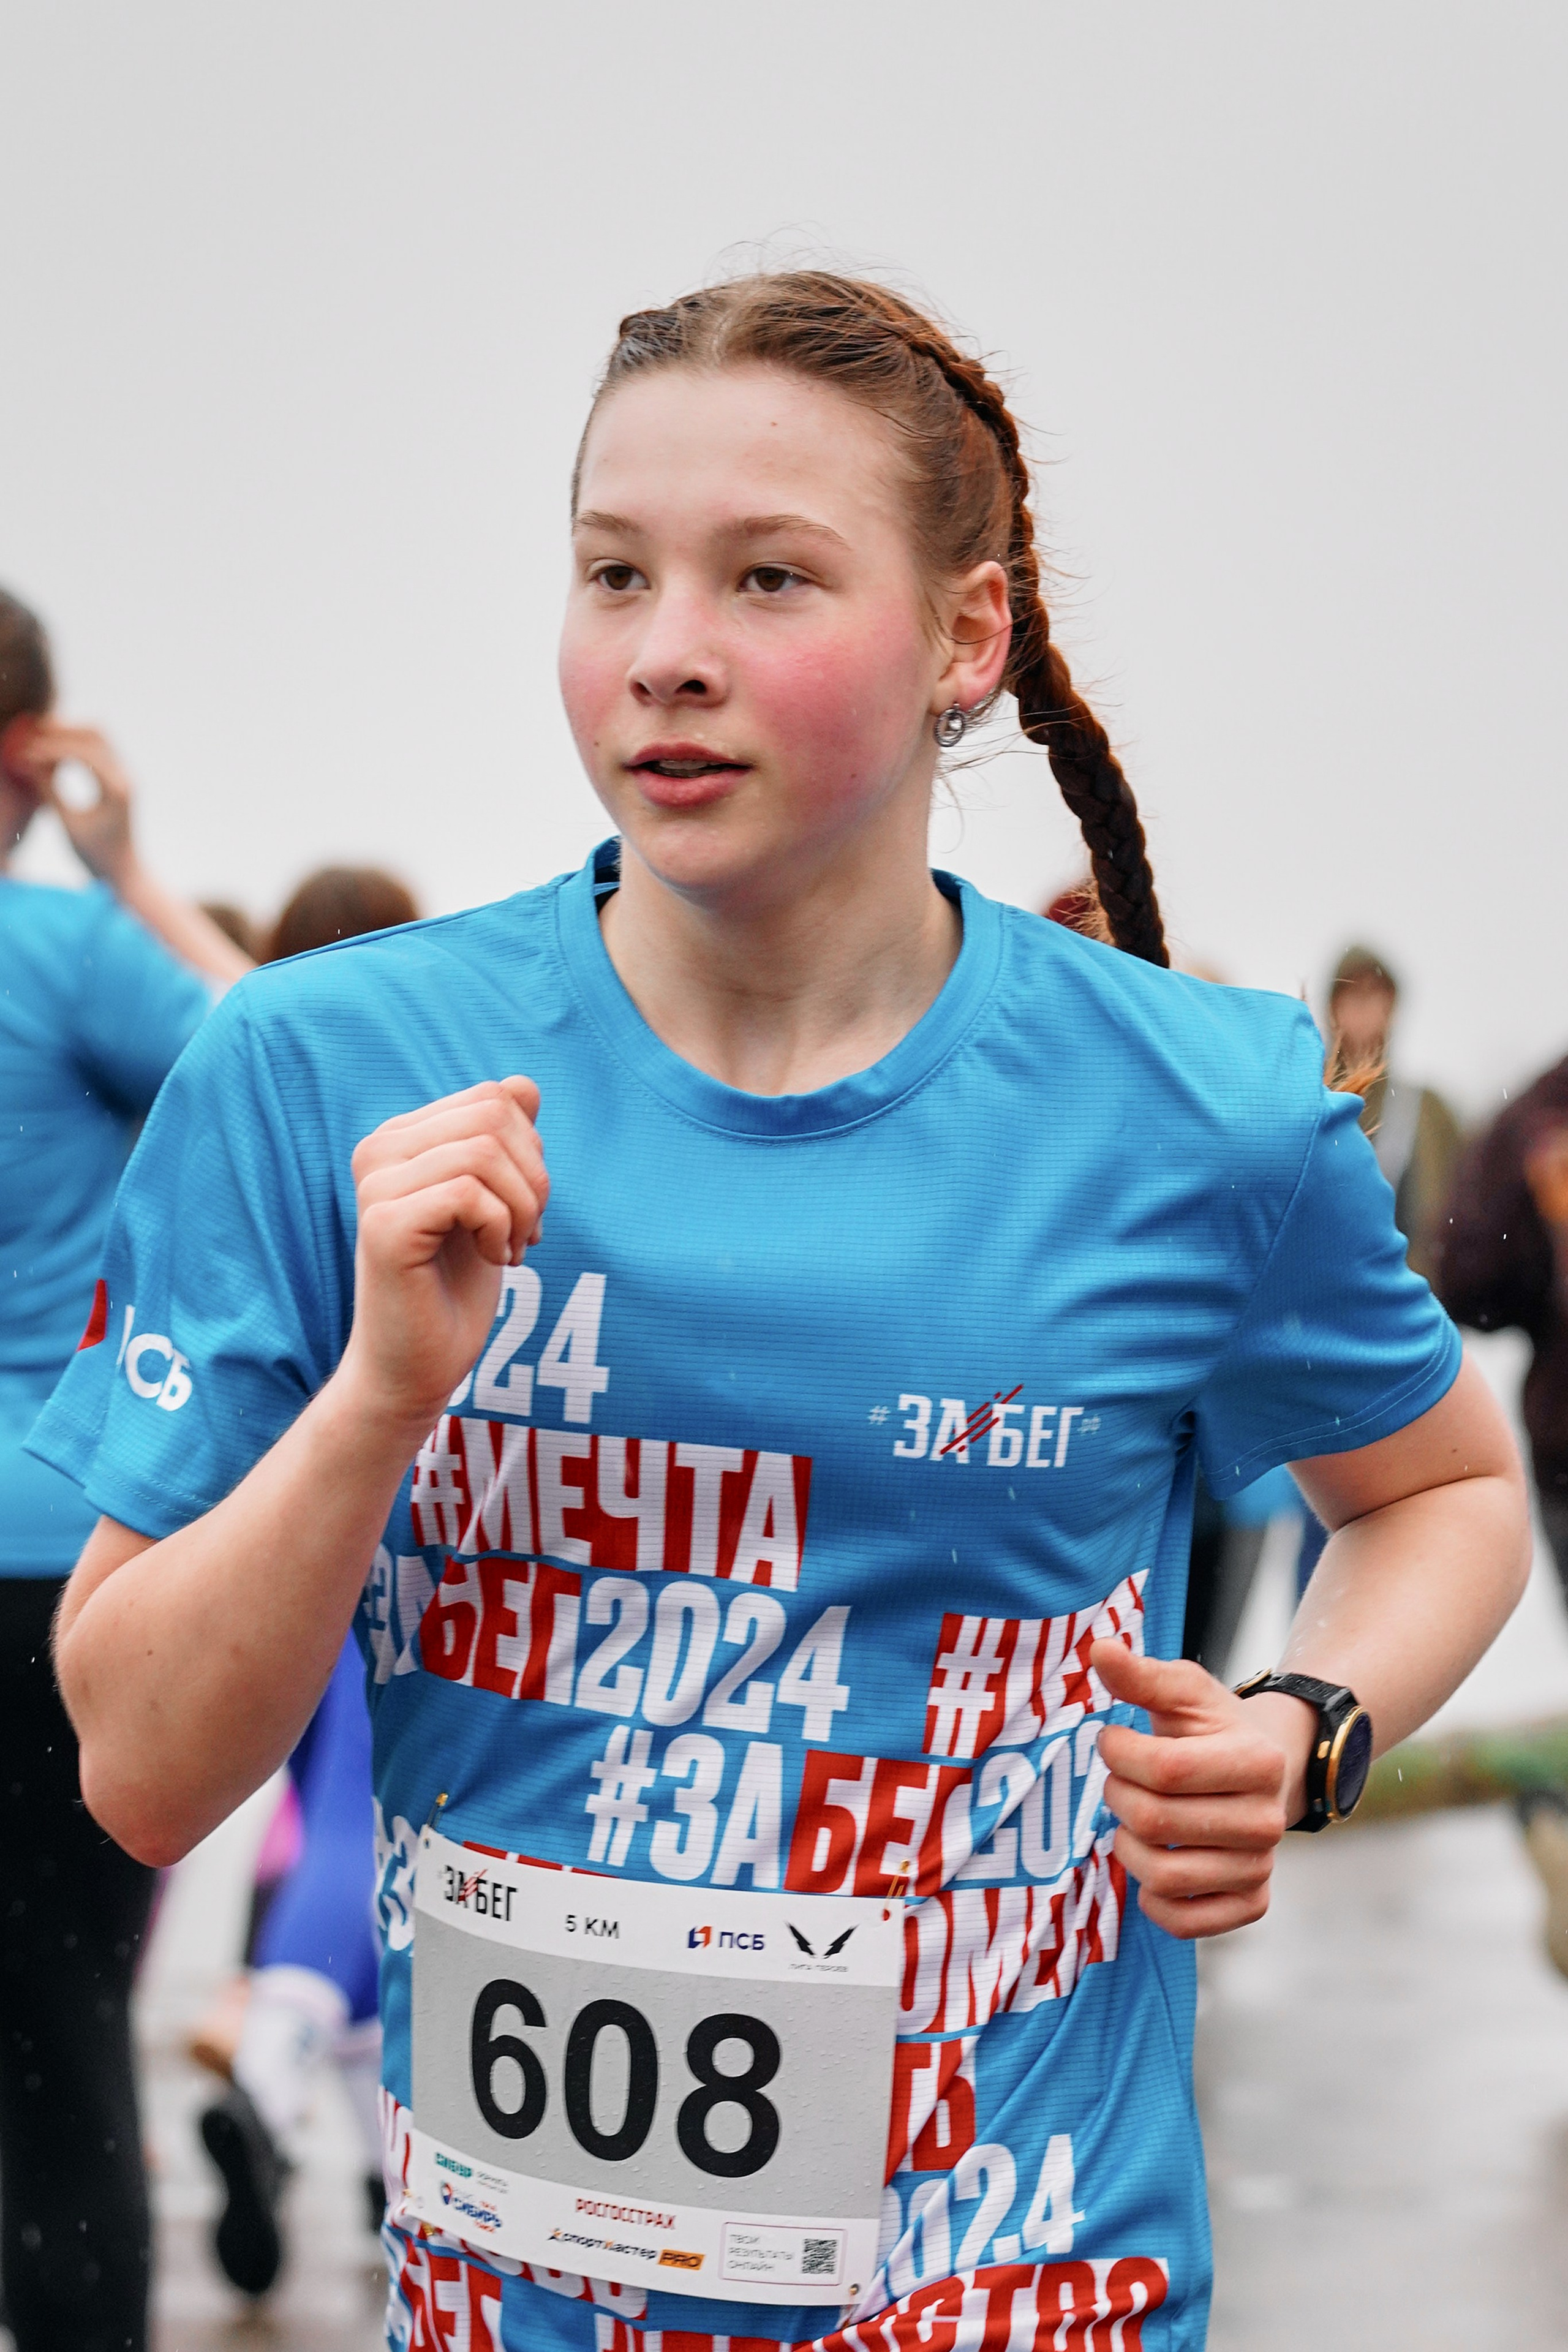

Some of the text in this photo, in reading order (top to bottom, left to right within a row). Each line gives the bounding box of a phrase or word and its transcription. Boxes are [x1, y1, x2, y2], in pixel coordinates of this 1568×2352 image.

[411, 1412, 800, 1593] #МЕЧТА
[585, 1720, 1116, 1895] #ЗАБЕГ202
[565, 1914, 620, 1939] 5 КМ
[719, 1931, 764, 1951] ПСБ
[470, 1978, 781, 2178] 608
